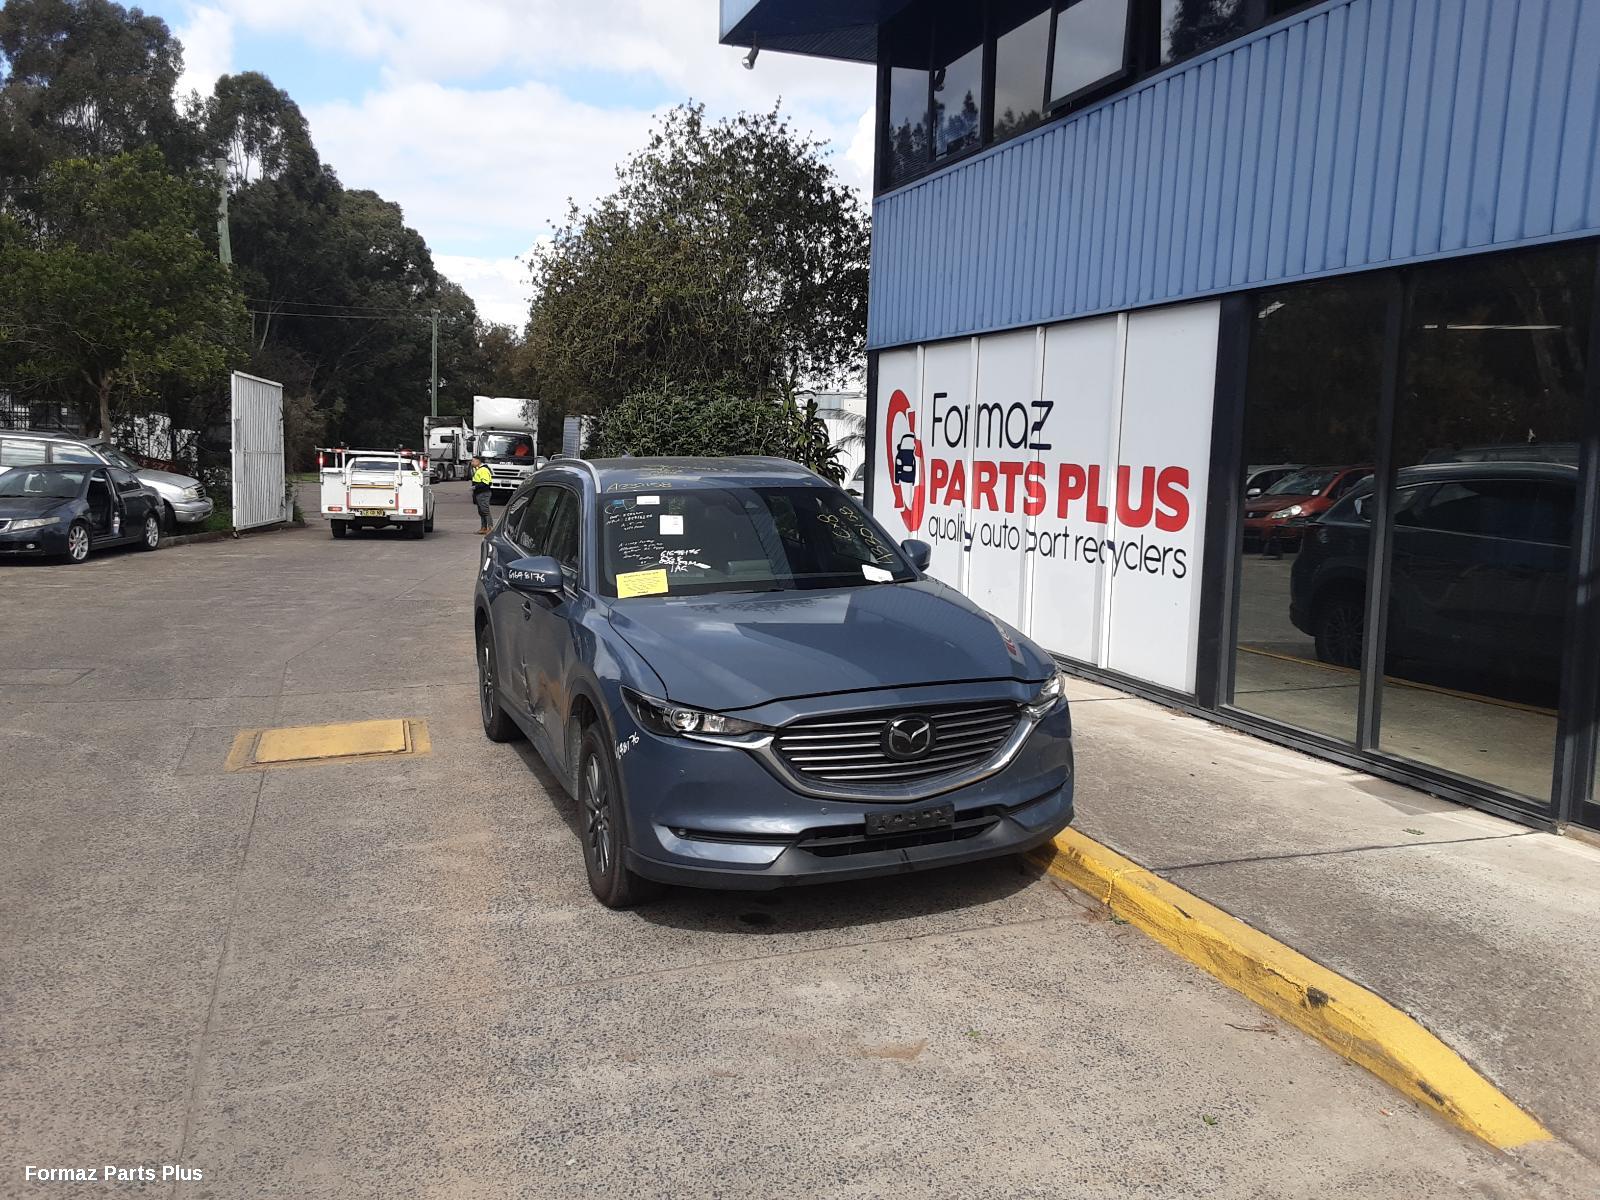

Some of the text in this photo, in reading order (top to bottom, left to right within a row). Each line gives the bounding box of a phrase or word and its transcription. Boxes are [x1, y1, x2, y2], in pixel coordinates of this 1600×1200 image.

[931, 392, 1054, 450] Formaz
[929, 459, 1190, 533] PARTS PLUS
[928, 512, 977, 552] qualiy
[980, 518, 1020, 550] auto
[1074, 534, 1187, 579] recyclers
